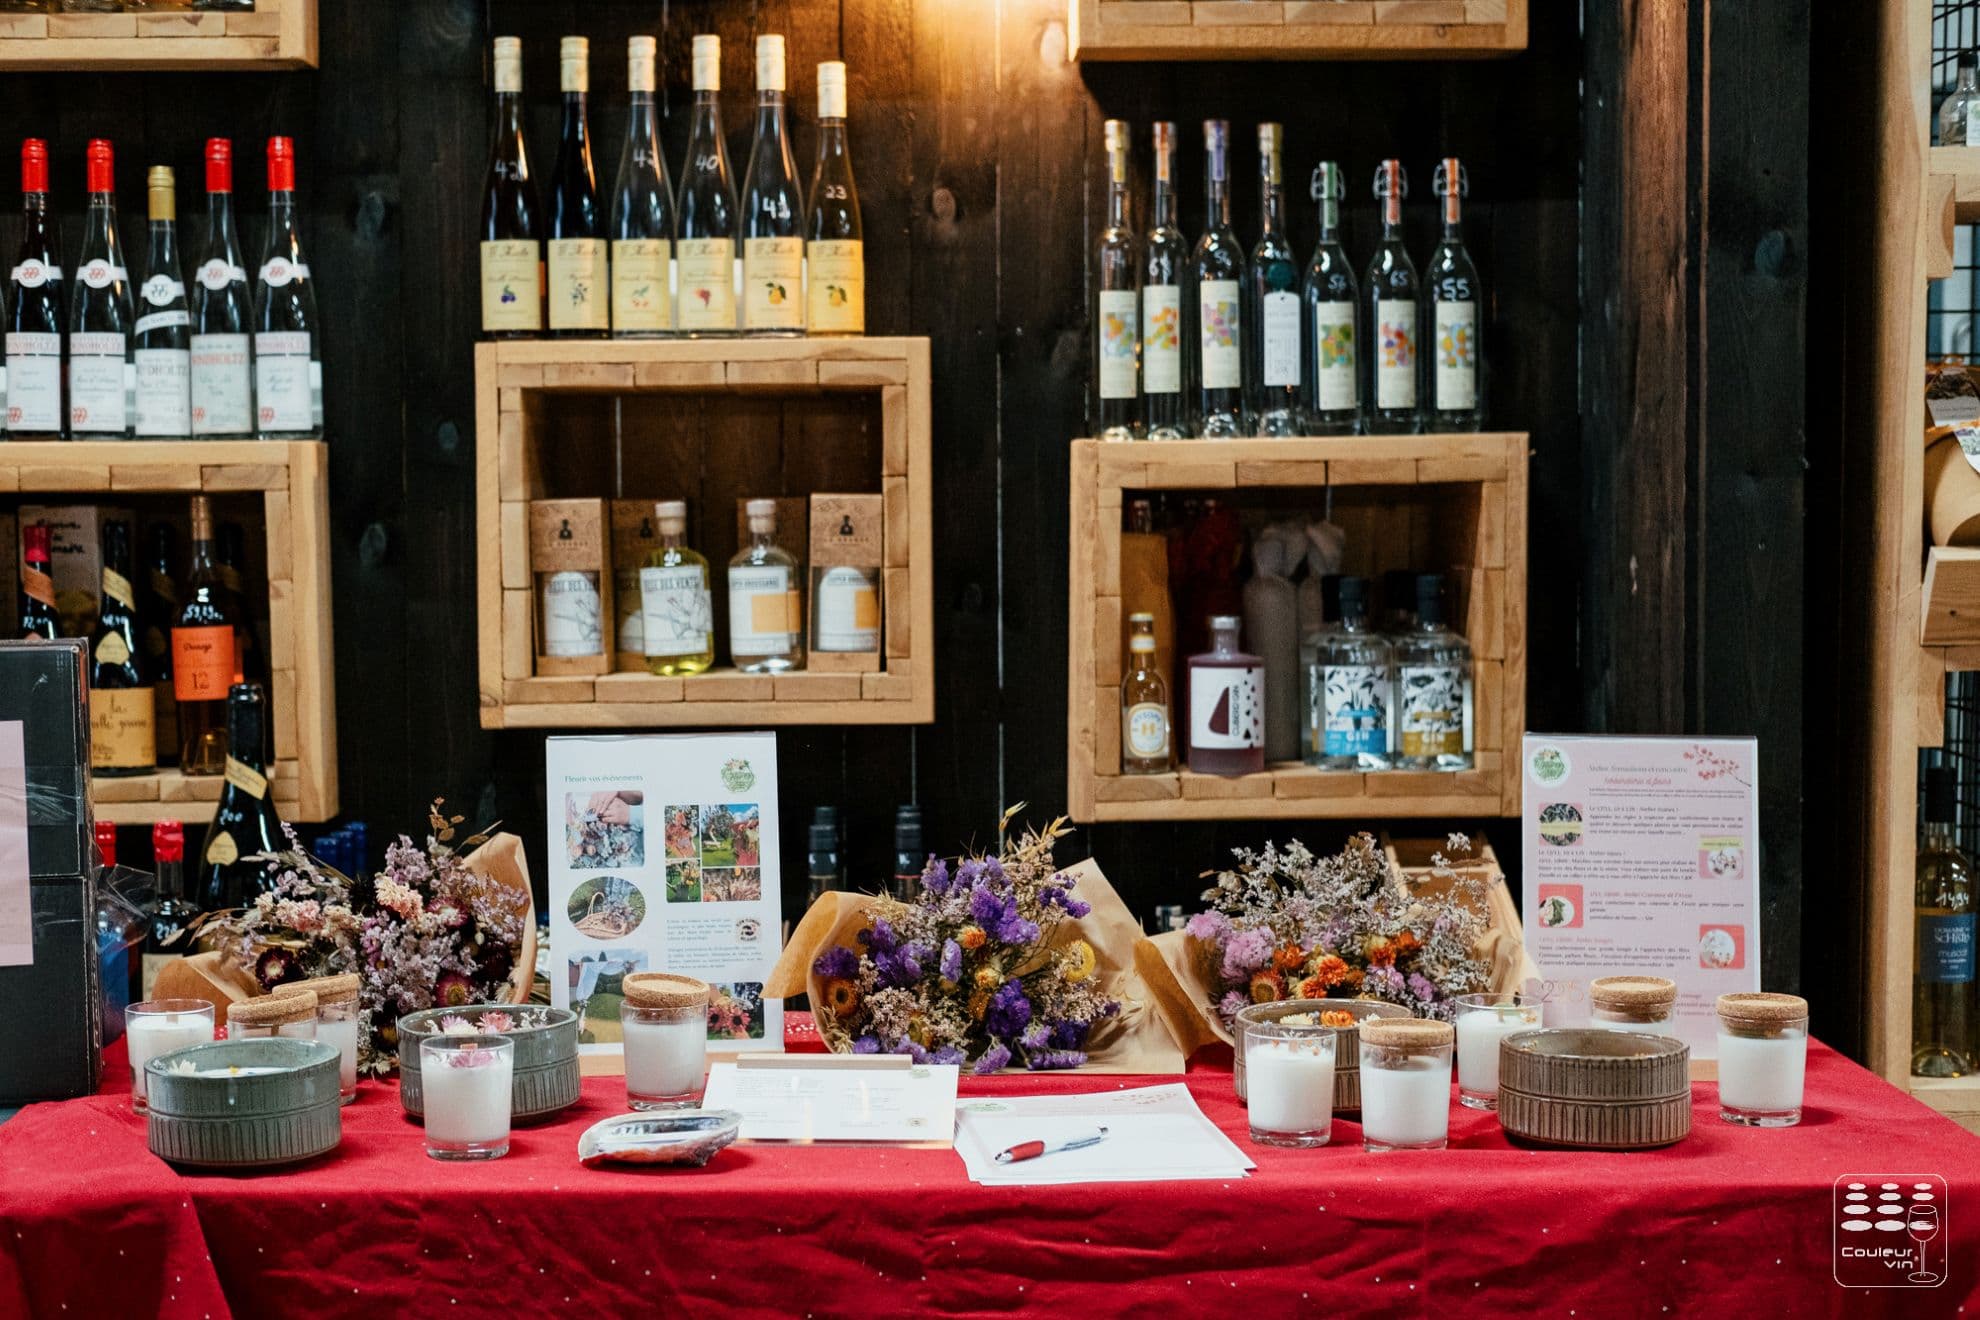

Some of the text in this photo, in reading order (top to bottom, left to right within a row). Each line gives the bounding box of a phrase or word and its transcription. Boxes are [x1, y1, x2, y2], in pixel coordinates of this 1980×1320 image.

[695, 153, 720, 172] 40
[1438, 277, 1468, 300] 55
[1346, 730, 1370, 742] GIN
